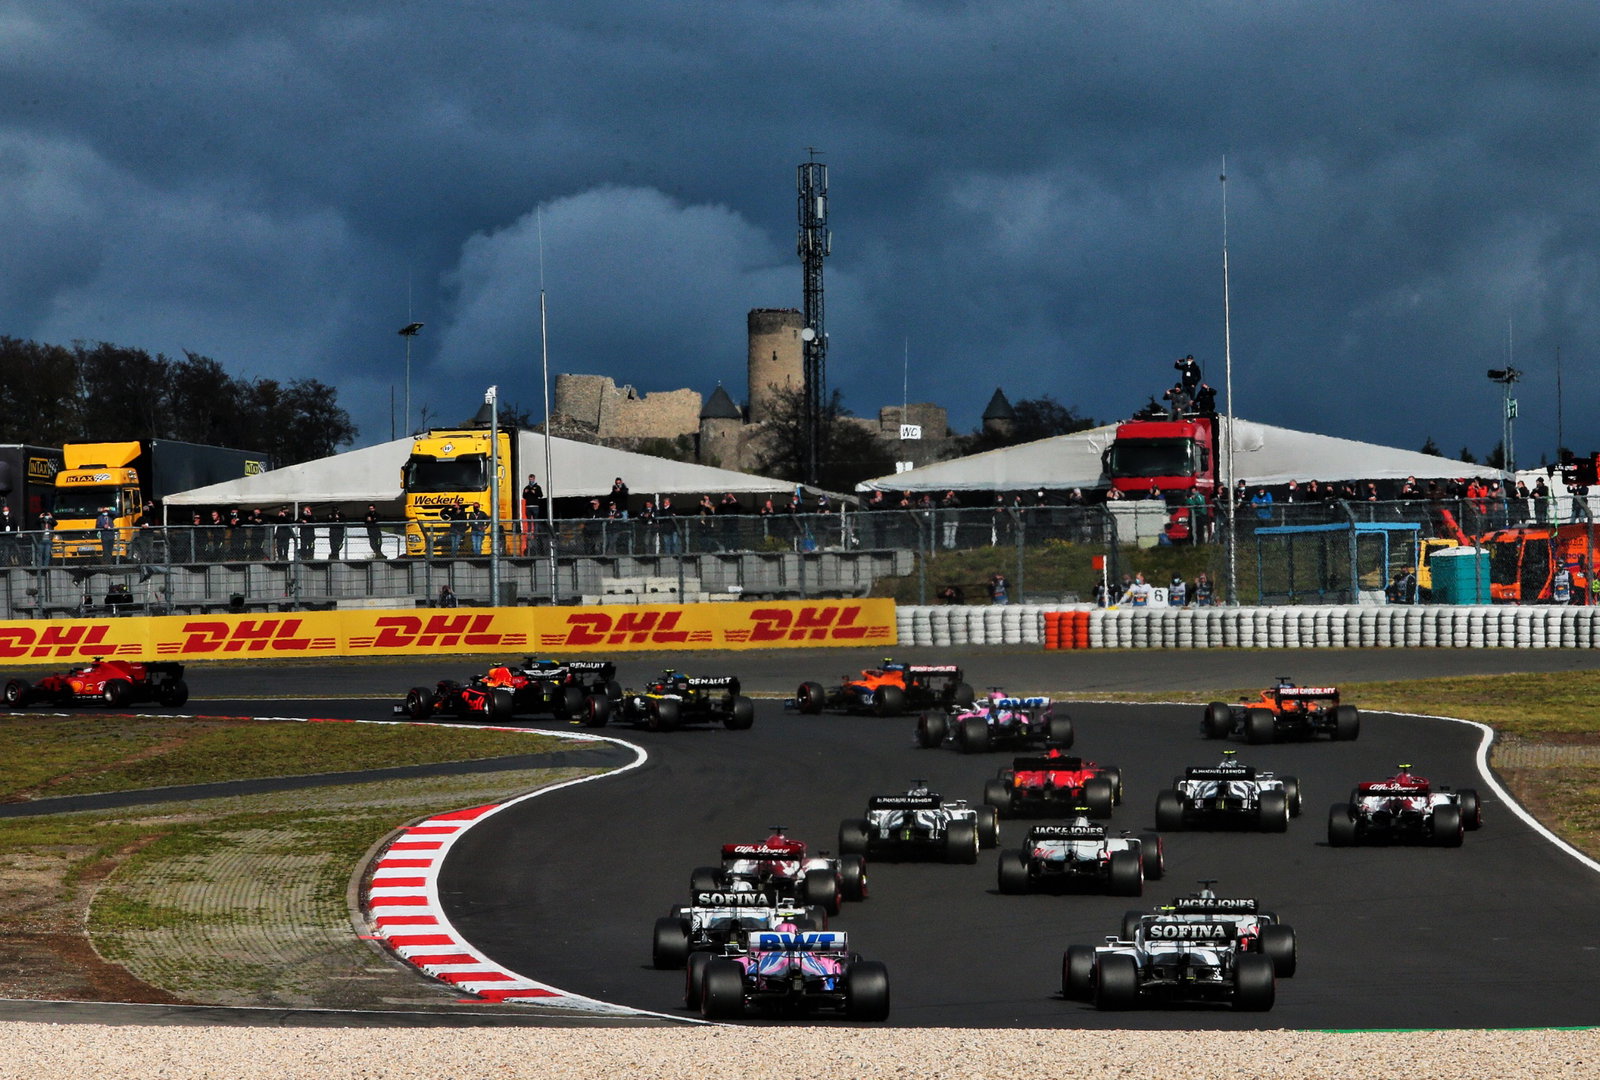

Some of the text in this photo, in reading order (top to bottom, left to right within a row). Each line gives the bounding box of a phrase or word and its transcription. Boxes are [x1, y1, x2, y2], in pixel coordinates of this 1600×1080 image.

[902, 427, 918, 437] WC
[30, 462, 48, 474] INTAX
[66, 475, 95, 483] INTAX
[414, 495, 465, 505] Weckerle
[1154, 589, 1164, 602] 6
[373, 615, 502, 647] DHL
[564, 611, 690, 646] DHL
[748, 606, 868, 642] DHL
[0, 625, 118, 657] DHL
[181, 619, 311, 653] DHL
[688, 677, 732, 685] RENAULT
[698, 892, 770, 907] SOFINA
[1150, 925, 1226, 939] SOFINA
[759, 933, 836, 951] BWT
